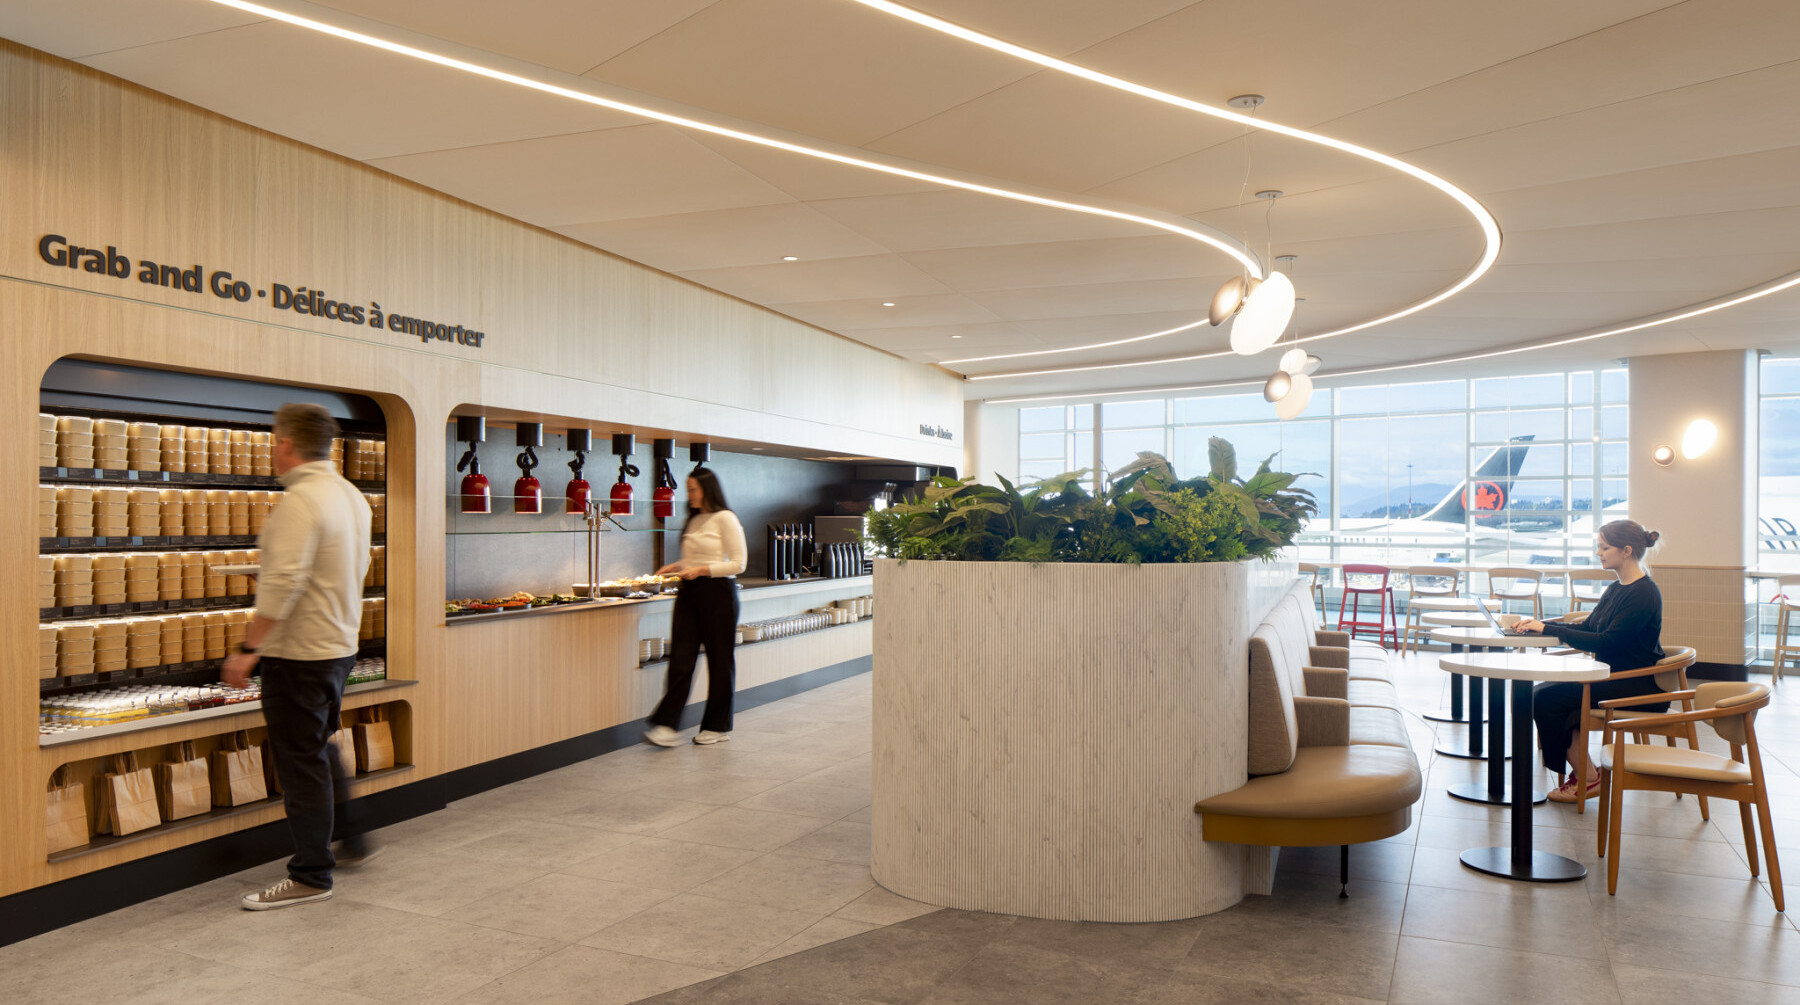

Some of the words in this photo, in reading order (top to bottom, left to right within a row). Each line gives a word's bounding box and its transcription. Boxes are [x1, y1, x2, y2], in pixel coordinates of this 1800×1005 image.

[38, 234, 131, 279] Grab
[138, 260, 203, 293] and
[210, 271, 251, 302] Go
[272, 283, 366, 325] Délices
[369, 302, 384, 329] à
[388, 313, 485, 348] emporter
